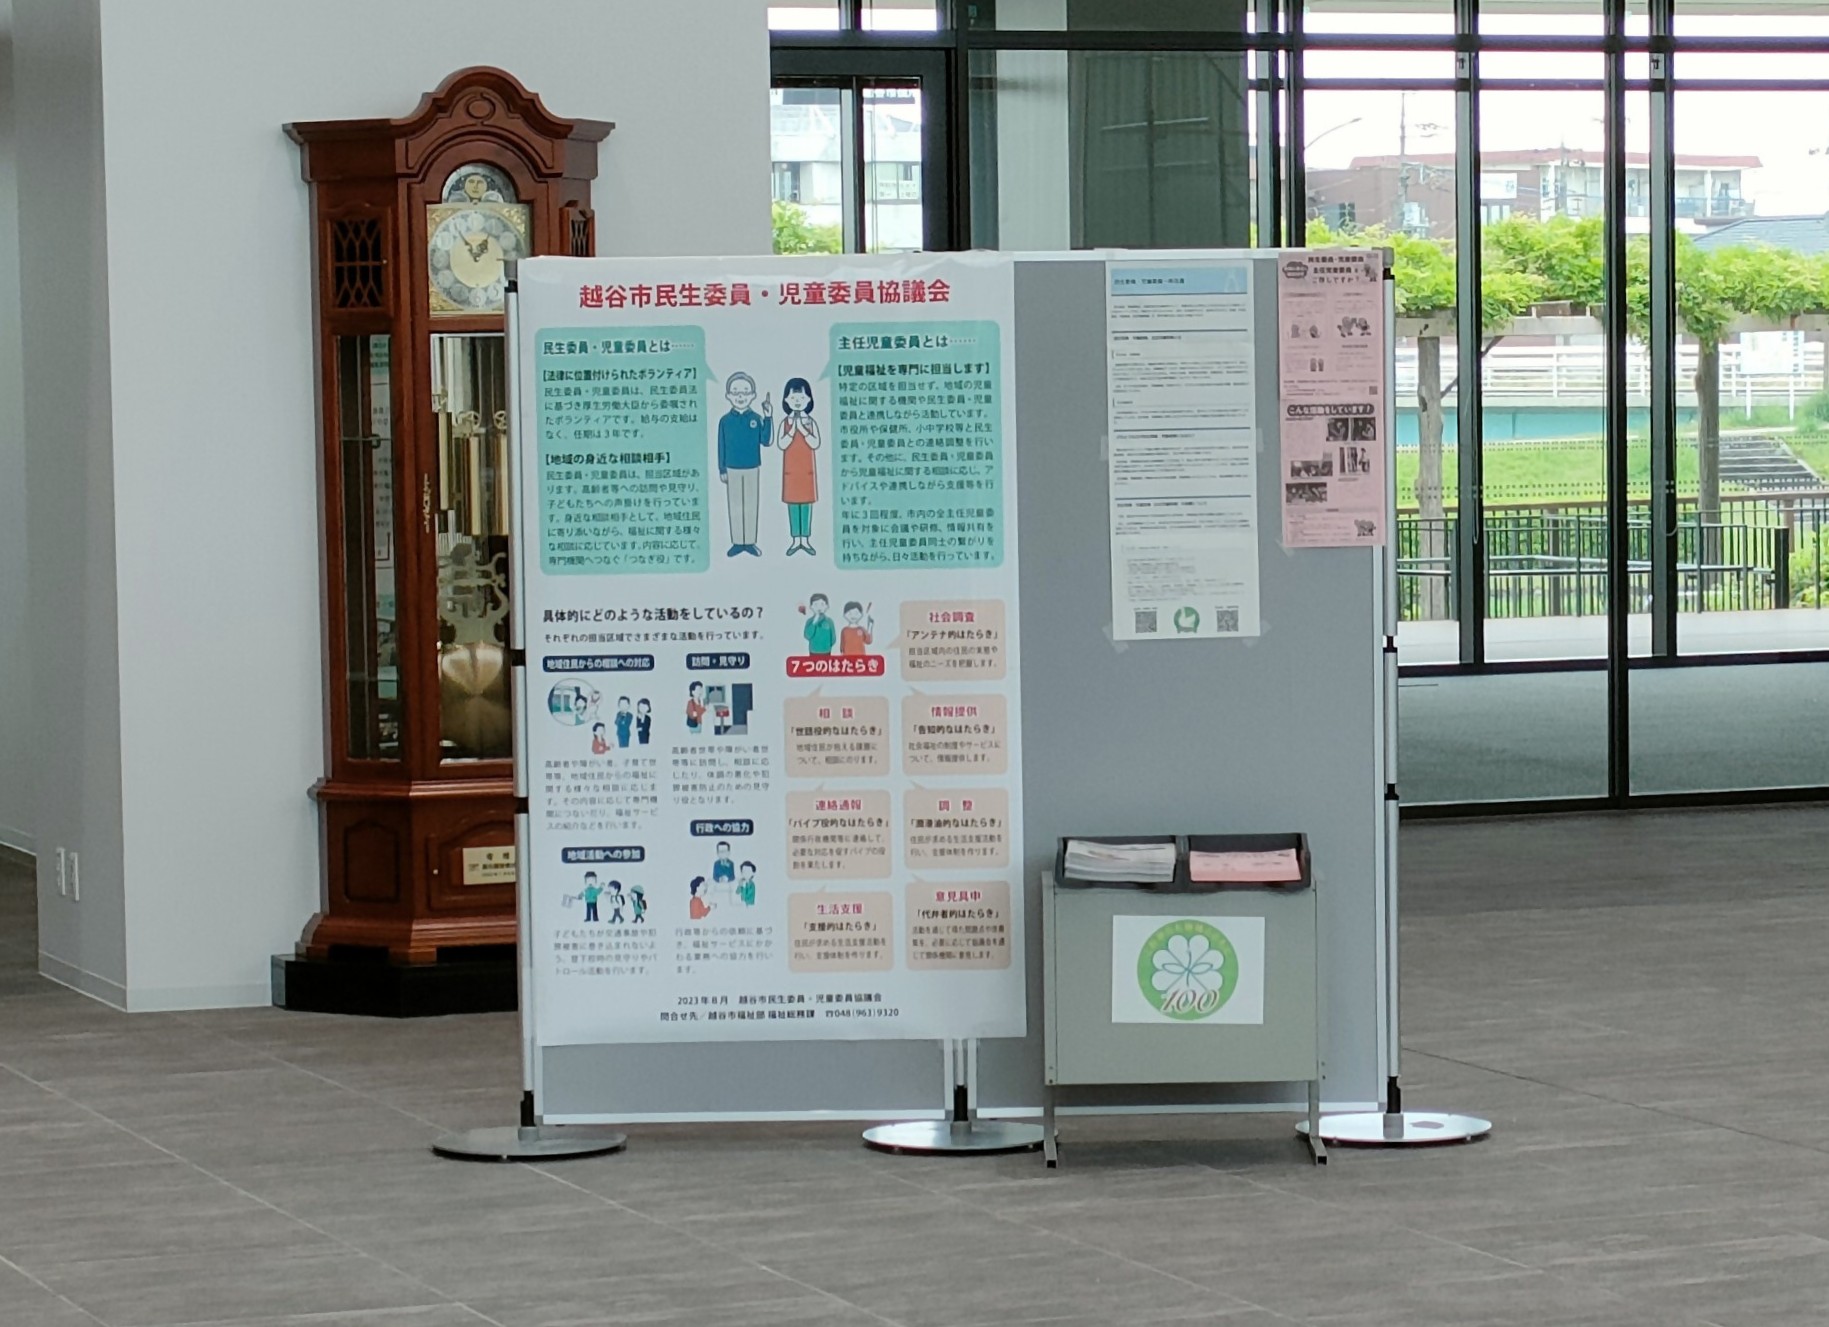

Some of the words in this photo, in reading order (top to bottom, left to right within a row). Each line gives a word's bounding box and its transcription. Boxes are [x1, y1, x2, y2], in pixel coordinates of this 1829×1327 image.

[579, 279, 951, 308] 越谷市民生委員・児童委員協議会
[546, 452, 671, 465] 【地域の身近な相談相手】
[841, 495, 873, 506] います。
[543, 606, 764, 623] 具体的にどのような活動をしているの？
[929, 611, 975, 623] 社会調査
[905, 629, 999, 641] 「アンテナ的はたらき」
[791, 659, 879, 674] 7つのはたらき
[931, 706, 977, 717] 情報提供
[790, 725, 883, 737] 「世話役的なはたらき」
[911, 723, 997, 735] 「告知的なはたらき」
[815, 799, 862, 811] 連絡通報
[695, 823, 750, 833] 行政への協力
[788, 818, 889, 829] 「パイプ役的なはたらき」
[935, 890, 981, 902] 意見具申
[816, 903, 863, 915] 生活支援
[916, 909, 1000, 920] 「代弁者的はたらき」
[803, 921, 878, 932] 「支援的はたらき」
[677, 995, 729, 1006] 2023年8月
